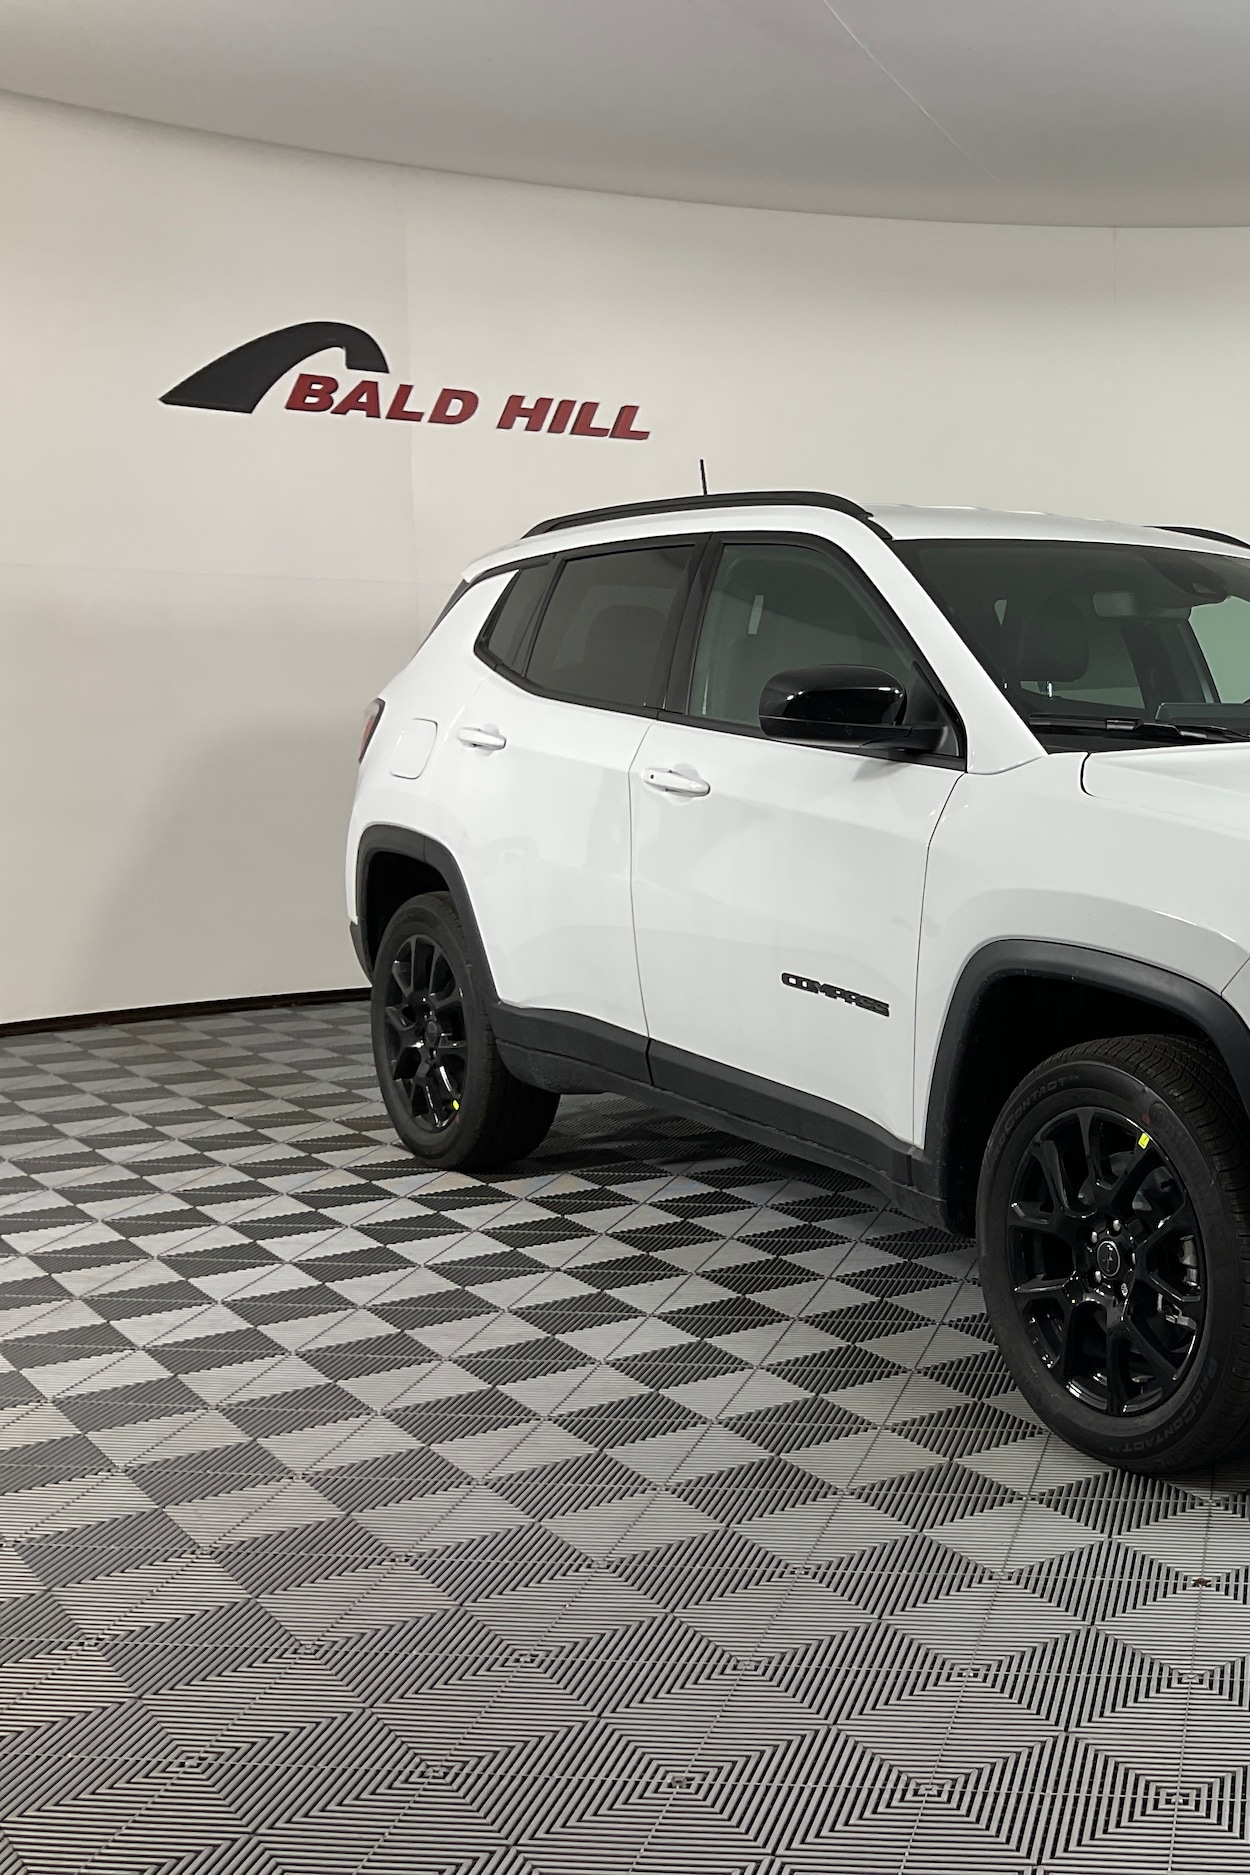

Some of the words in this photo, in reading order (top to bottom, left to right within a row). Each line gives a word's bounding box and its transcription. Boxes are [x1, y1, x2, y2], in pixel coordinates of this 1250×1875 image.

[285, 373, 479, 425] BALD
[496, 394, 650, 440] HILL
[782, 972, 890, 1018] COMPASS
